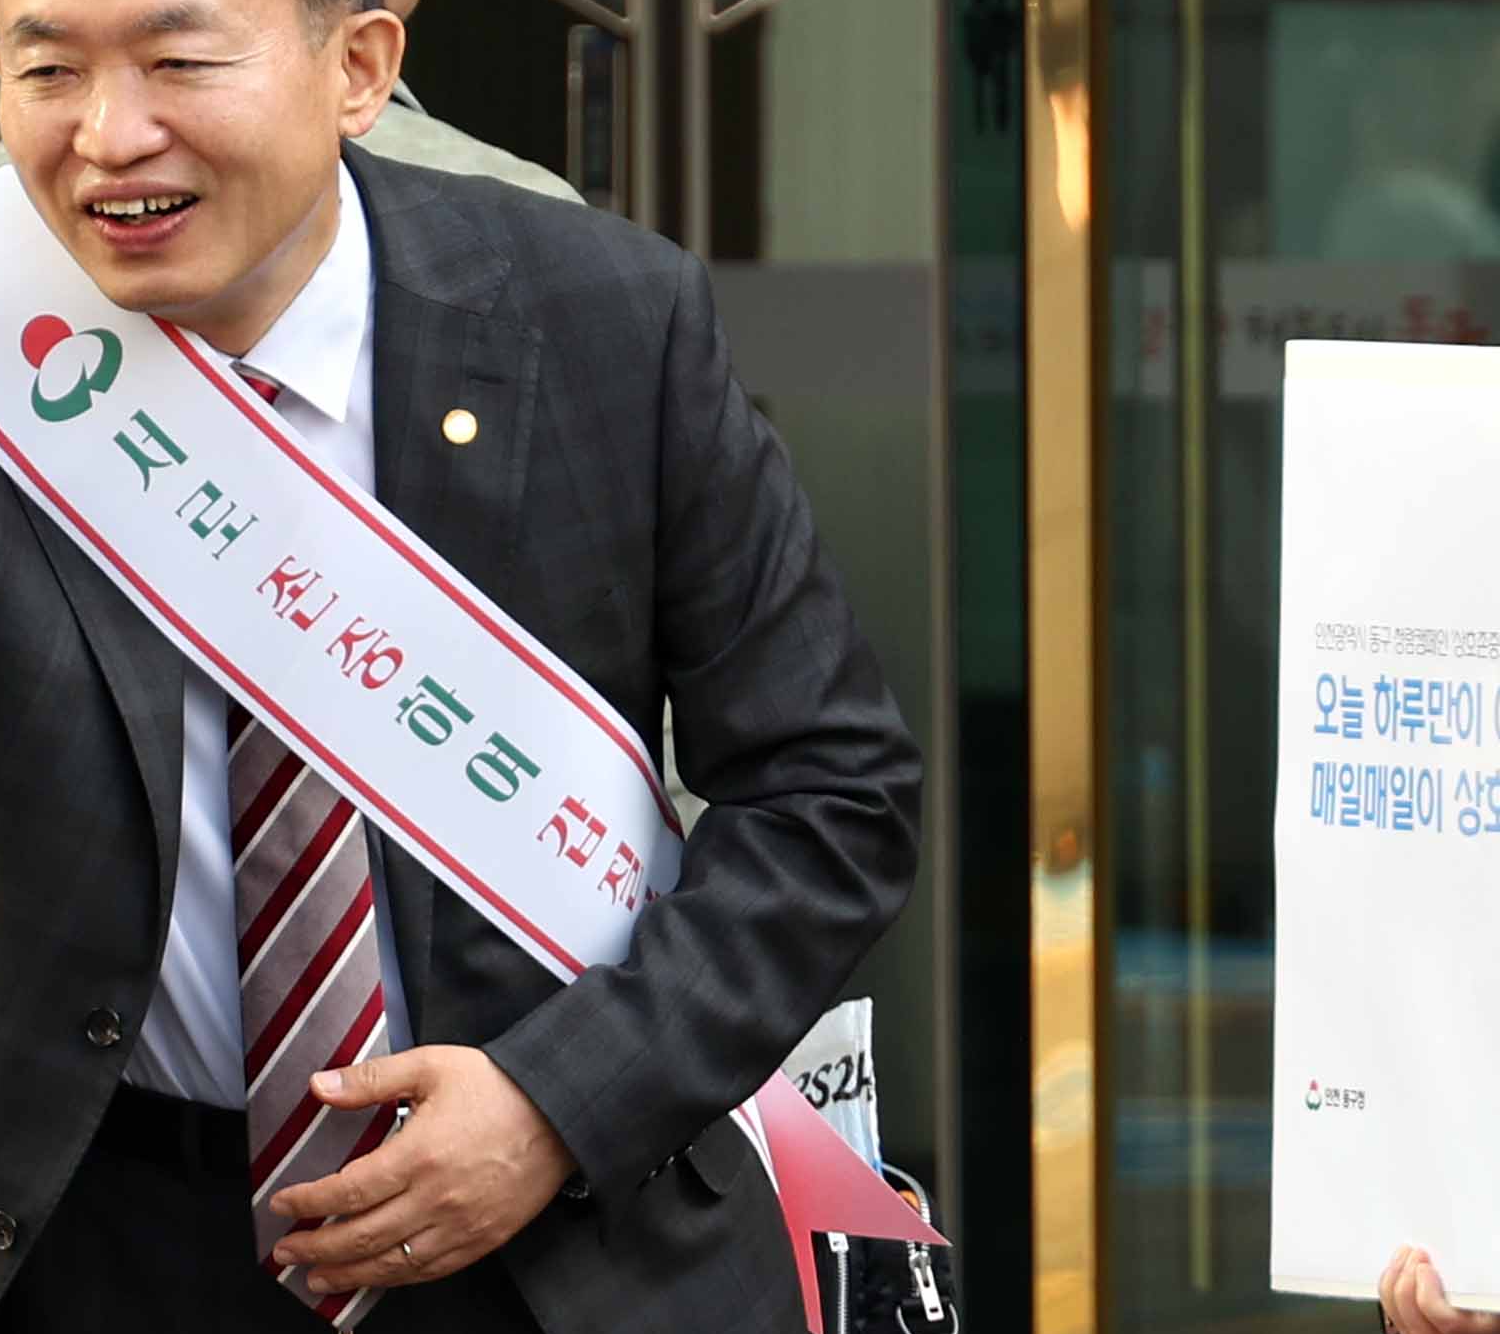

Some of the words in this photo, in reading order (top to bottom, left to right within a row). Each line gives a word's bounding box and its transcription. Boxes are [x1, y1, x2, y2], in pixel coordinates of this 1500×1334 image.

[112, 408, 260, 560] 서로
[256, 552, 543, 803] 존중하여
[1313, 671, 1366, 740] 오늘
[1373, 673, 1483, 748] 하루만이
[1310, 759, 1444, 836] 매일매일이
